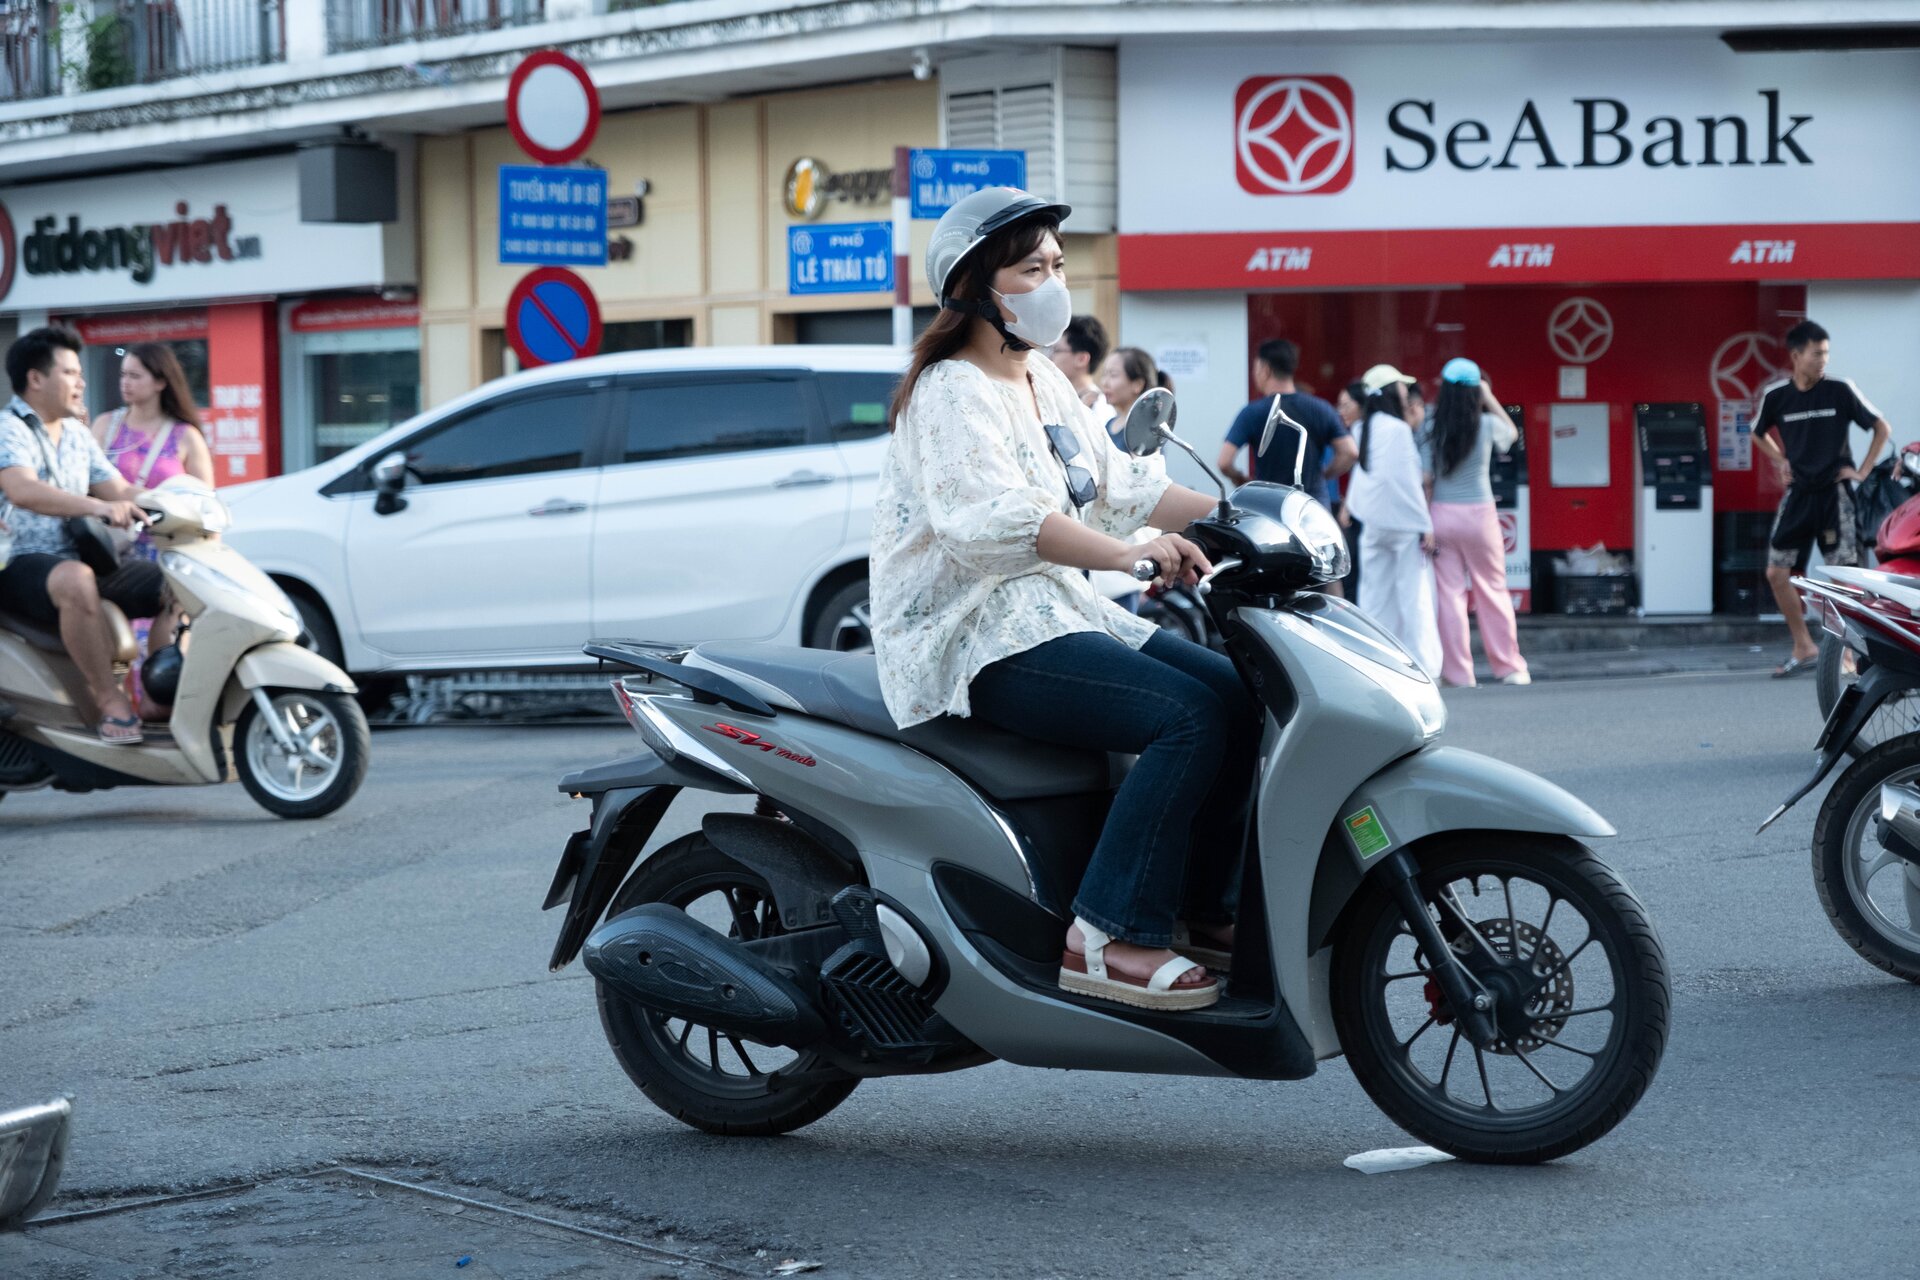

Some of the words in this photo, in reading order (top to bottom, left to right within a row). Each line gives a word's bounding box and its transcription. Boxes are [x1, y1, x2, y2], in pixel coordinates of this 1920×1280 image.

[1385, 89, 1815, 172] SeABank
[952, 158, 990, 176] PHỐ
[829, 229, 865, 248] PHỐ
[1246, 246, 1313, 272] ATM
[1488, 243, 1556, 268] ATM
[1730, 239, 1797, 265] ATM
[821, 251, 862, 283] THÁI
